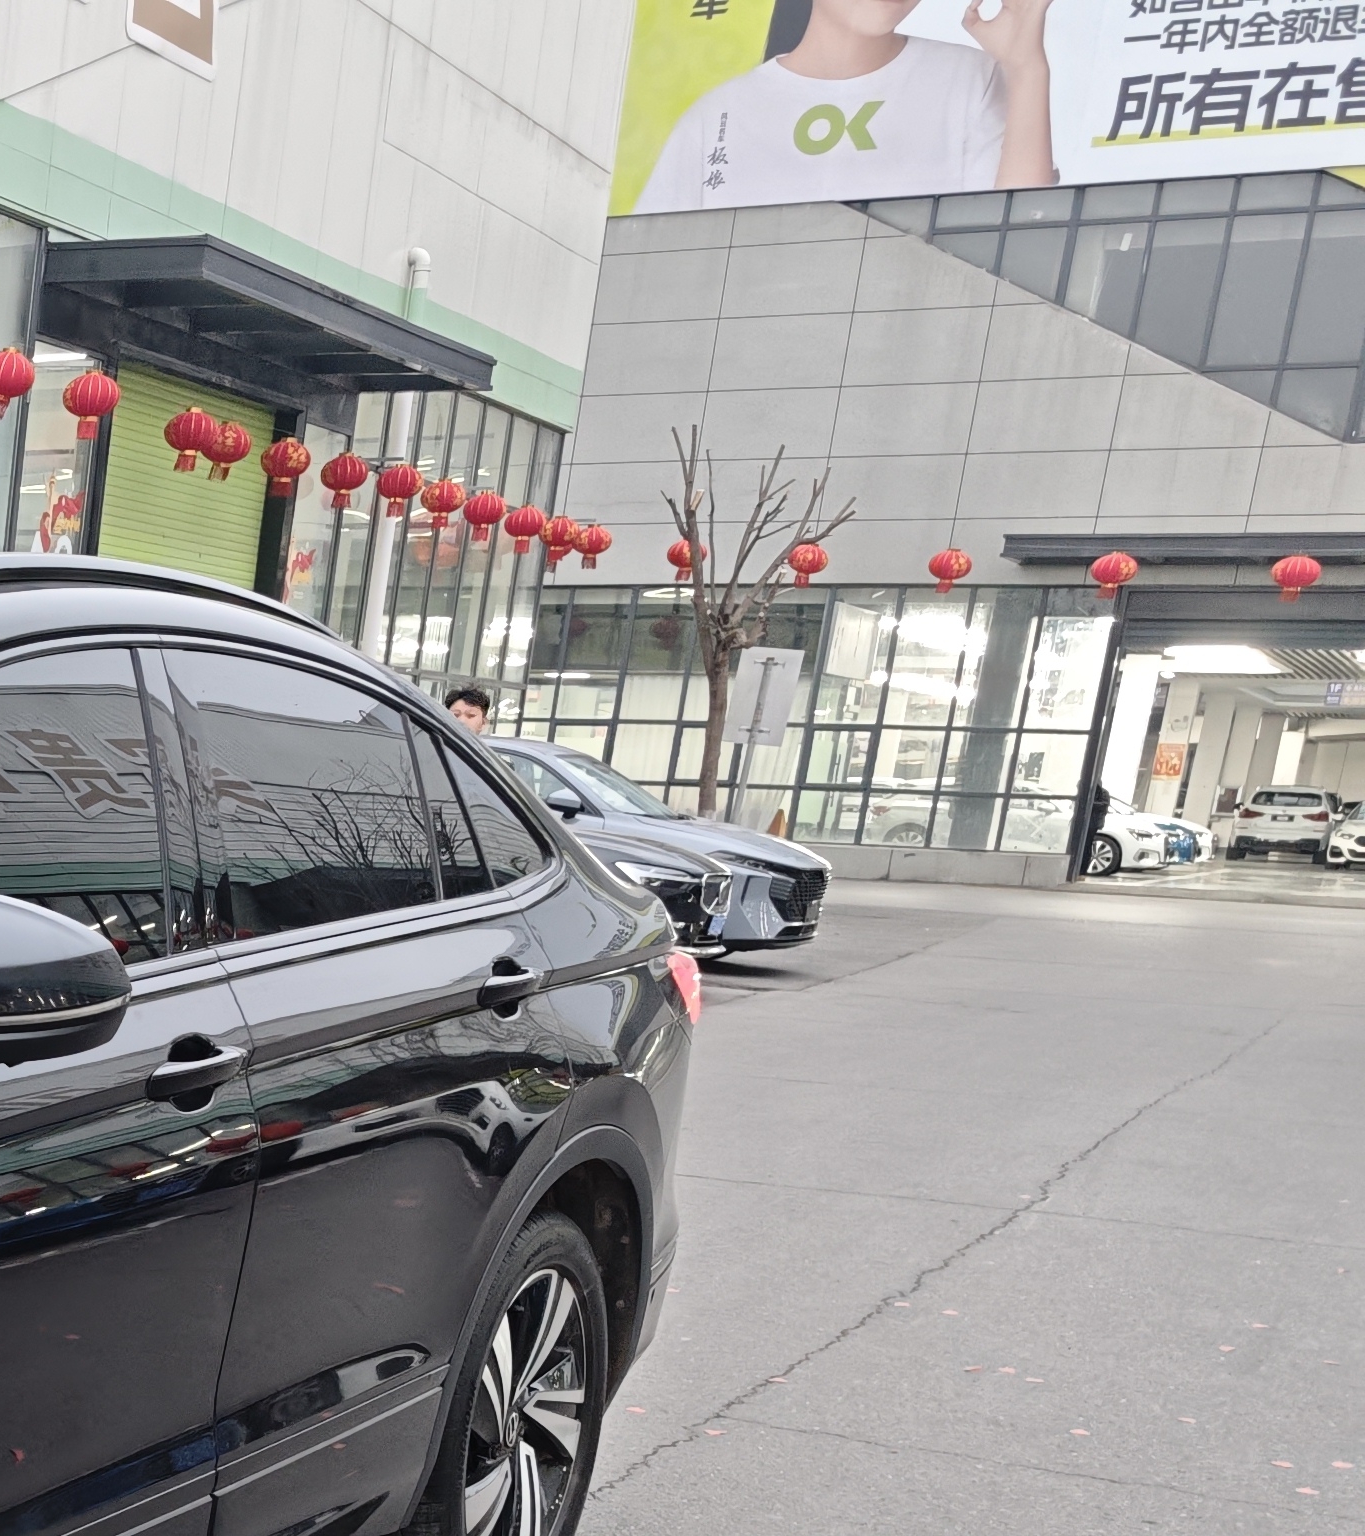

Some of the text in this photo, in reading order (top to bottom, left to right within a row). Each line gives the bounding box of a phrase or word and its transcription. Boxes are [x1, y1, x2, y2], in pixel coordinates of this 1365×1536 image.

[1124, 5, 1365, 54] 一年内全额退
[793, 101, 885, 156] OK
